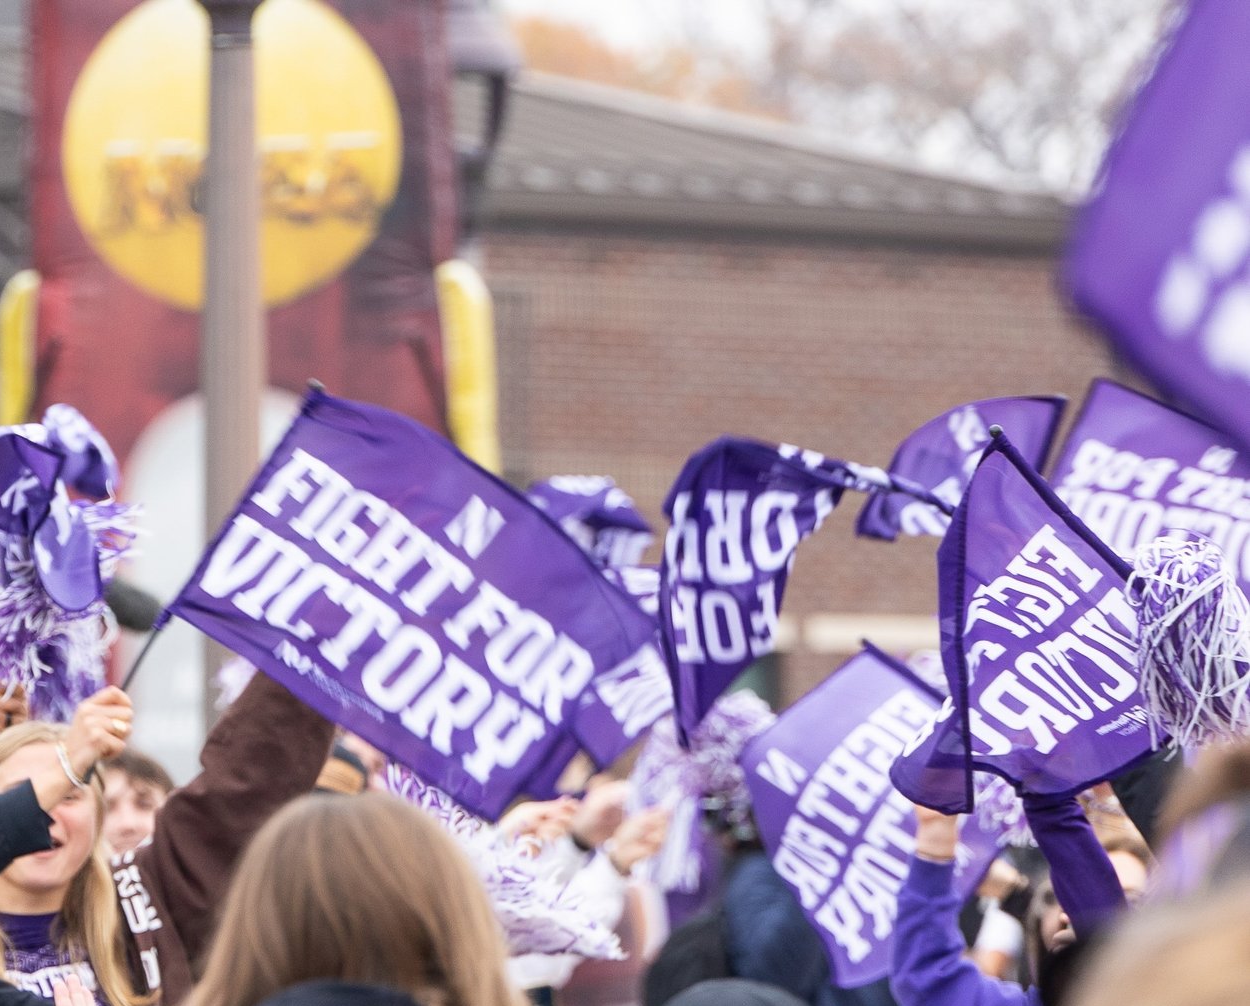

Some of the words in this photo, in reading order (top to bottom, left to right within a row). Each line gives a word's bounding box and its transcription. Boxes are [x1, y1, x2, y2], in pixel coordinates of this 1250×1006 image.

[199, 512, 547, 785] VICTORY
[251, 447, 476, 617] FIGHT
[442, 579, 596, 725] FOR
[443, 494, 507, 559] N
